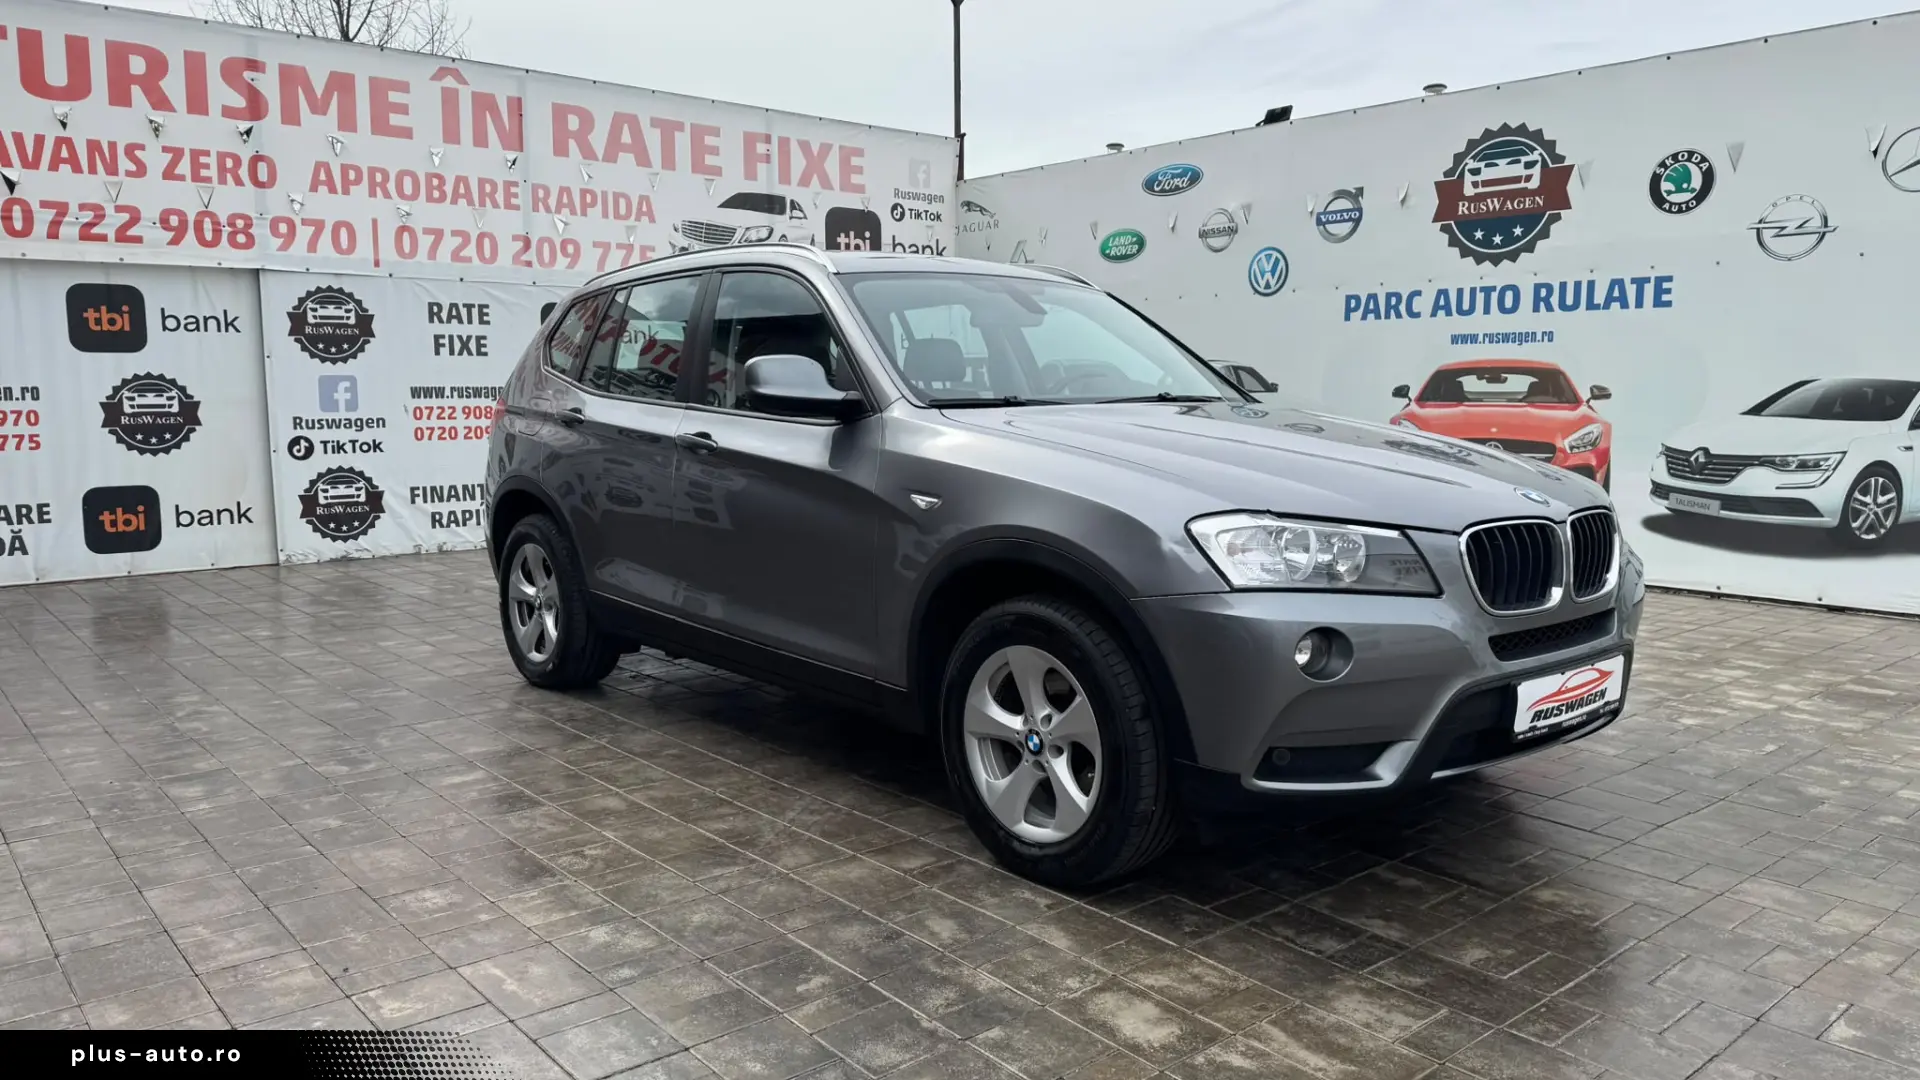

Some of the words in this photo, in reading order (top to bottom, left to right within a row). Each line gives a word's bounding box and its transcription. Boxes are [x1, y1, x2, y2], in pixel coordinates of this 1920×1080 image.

[0, 24, 414, 140] URISME
[429, 66, 524, 153] ÎN
[552, 101, 723, 178] RATE
[743, 130, 866, 194] FIXE
[161, 145, 278, 189] ZERO
[309, 160, 521, 212] APROBARE
[531, 182, 656, 224] RAPIDA
[1153, 167, 1191, 191] Ford
[893, 187, 945, 205] Ruswagen
[907, 208, 943, 222] TikTok
[1662, 200, 1697, 212] AUTO
[1319, 210, 1360, 222] VOLVO
[1, 196, 145, 245] 0722
[159, 208, 256, 250] 908
[269, 215, 357, 256] 970
[394, 224, 498, 265] 0720
[511, 234, 581, 270] 209
[954, 219, 999, 236] JAGUAR
[1202, 225, 1235, 236] NISSAN
[1109, 236, 1132, 247] LAND
[1110, 244, 1139, 256] ROVER
[1343, 289, 1422, 322] PARC
[1430, 284, 1521, 318] AUTO
[1532, 275, 1674, 313] RULATE
[83, 305, 131, 332] tbi
[160, 307, 241, 334] bank
[427, 301, 491, 326] RATE
[433, 334, 488, 357] FIXE
[1450, 330, 1555, 346] www.ruswagen.ro
[413, 405, 457, 421] 0722
[461, 405, 493, 420] 908
[292, 416, 386, 432] Ruswagen
[414, 426, 458, 441] 0720
[319, 439, 385, 455] TikTok
[99, 505, 146, 533] tbi
[175, 501, 254, 528] bank
[1530, 687, 1608, 724] RUSWAGEN
